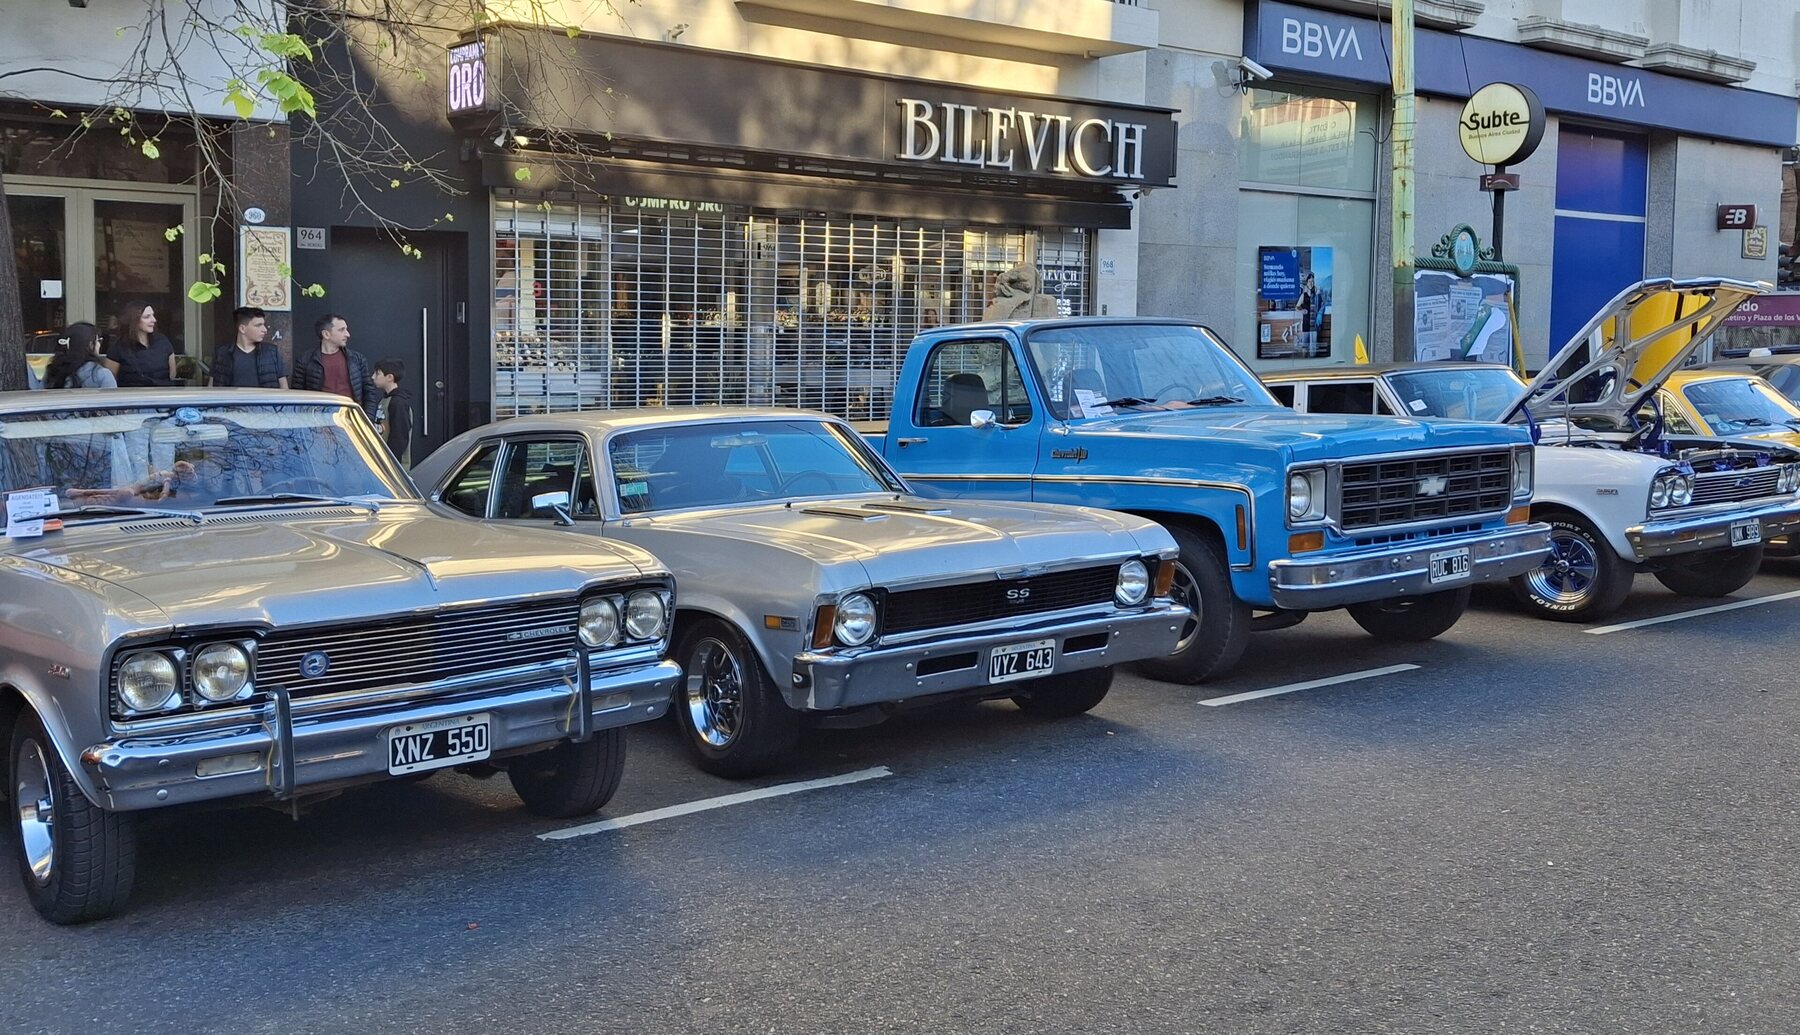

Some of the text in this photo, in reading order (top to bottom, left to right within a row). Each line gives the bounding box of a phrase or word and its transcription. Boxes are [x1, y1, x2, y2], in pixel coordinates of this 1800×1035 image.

[1282, 17, 1363, 60] BBVA
[450, 60, 485, 110] ORO
[1587, 72, 1645, 108] BBVA
[1469, 110, 1521, 131] Subte
[897, 98, 1147, 179] BILEVICH
[300, 229, 322, 240] 964
[1102, 260, 1114, 269] 968
[1753, 313, 1773, 321] Plaza
[1784, 313, 1795, 321] los
[1432, 555, 1469, 578] RUC 816
[1006, 588, 1030, 599] SS
[1529, 594, 1576, 611] DUNLOP
[523, 626, 570, 639] CHEVROLET
[993, 648, 1053, 677] VYZ 643
[394, 725, 487, 766] XNZ 550
